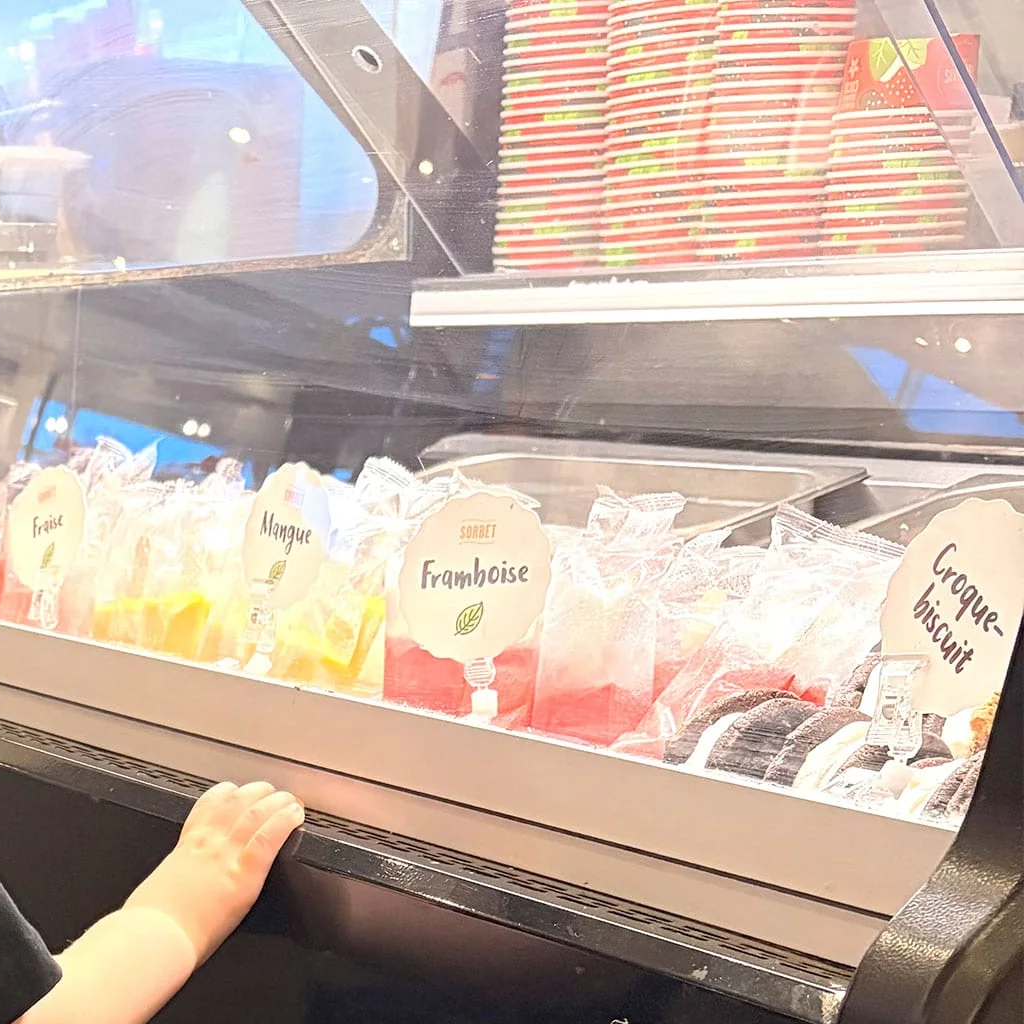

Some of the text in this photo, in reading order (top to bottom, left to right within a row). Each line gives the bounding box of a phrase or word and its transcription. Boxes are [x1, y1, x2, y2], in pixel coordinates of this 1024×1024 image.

[33, 514, 63, 538] Fraise
[260, 510, 312, 556] Mangue
[459, 524, 497, 540] SORBET
[421, 557, 529, 589] Framboise
[932, 542, 1004, 637] Croque-
[913, 581, 974, 674] biscuit
